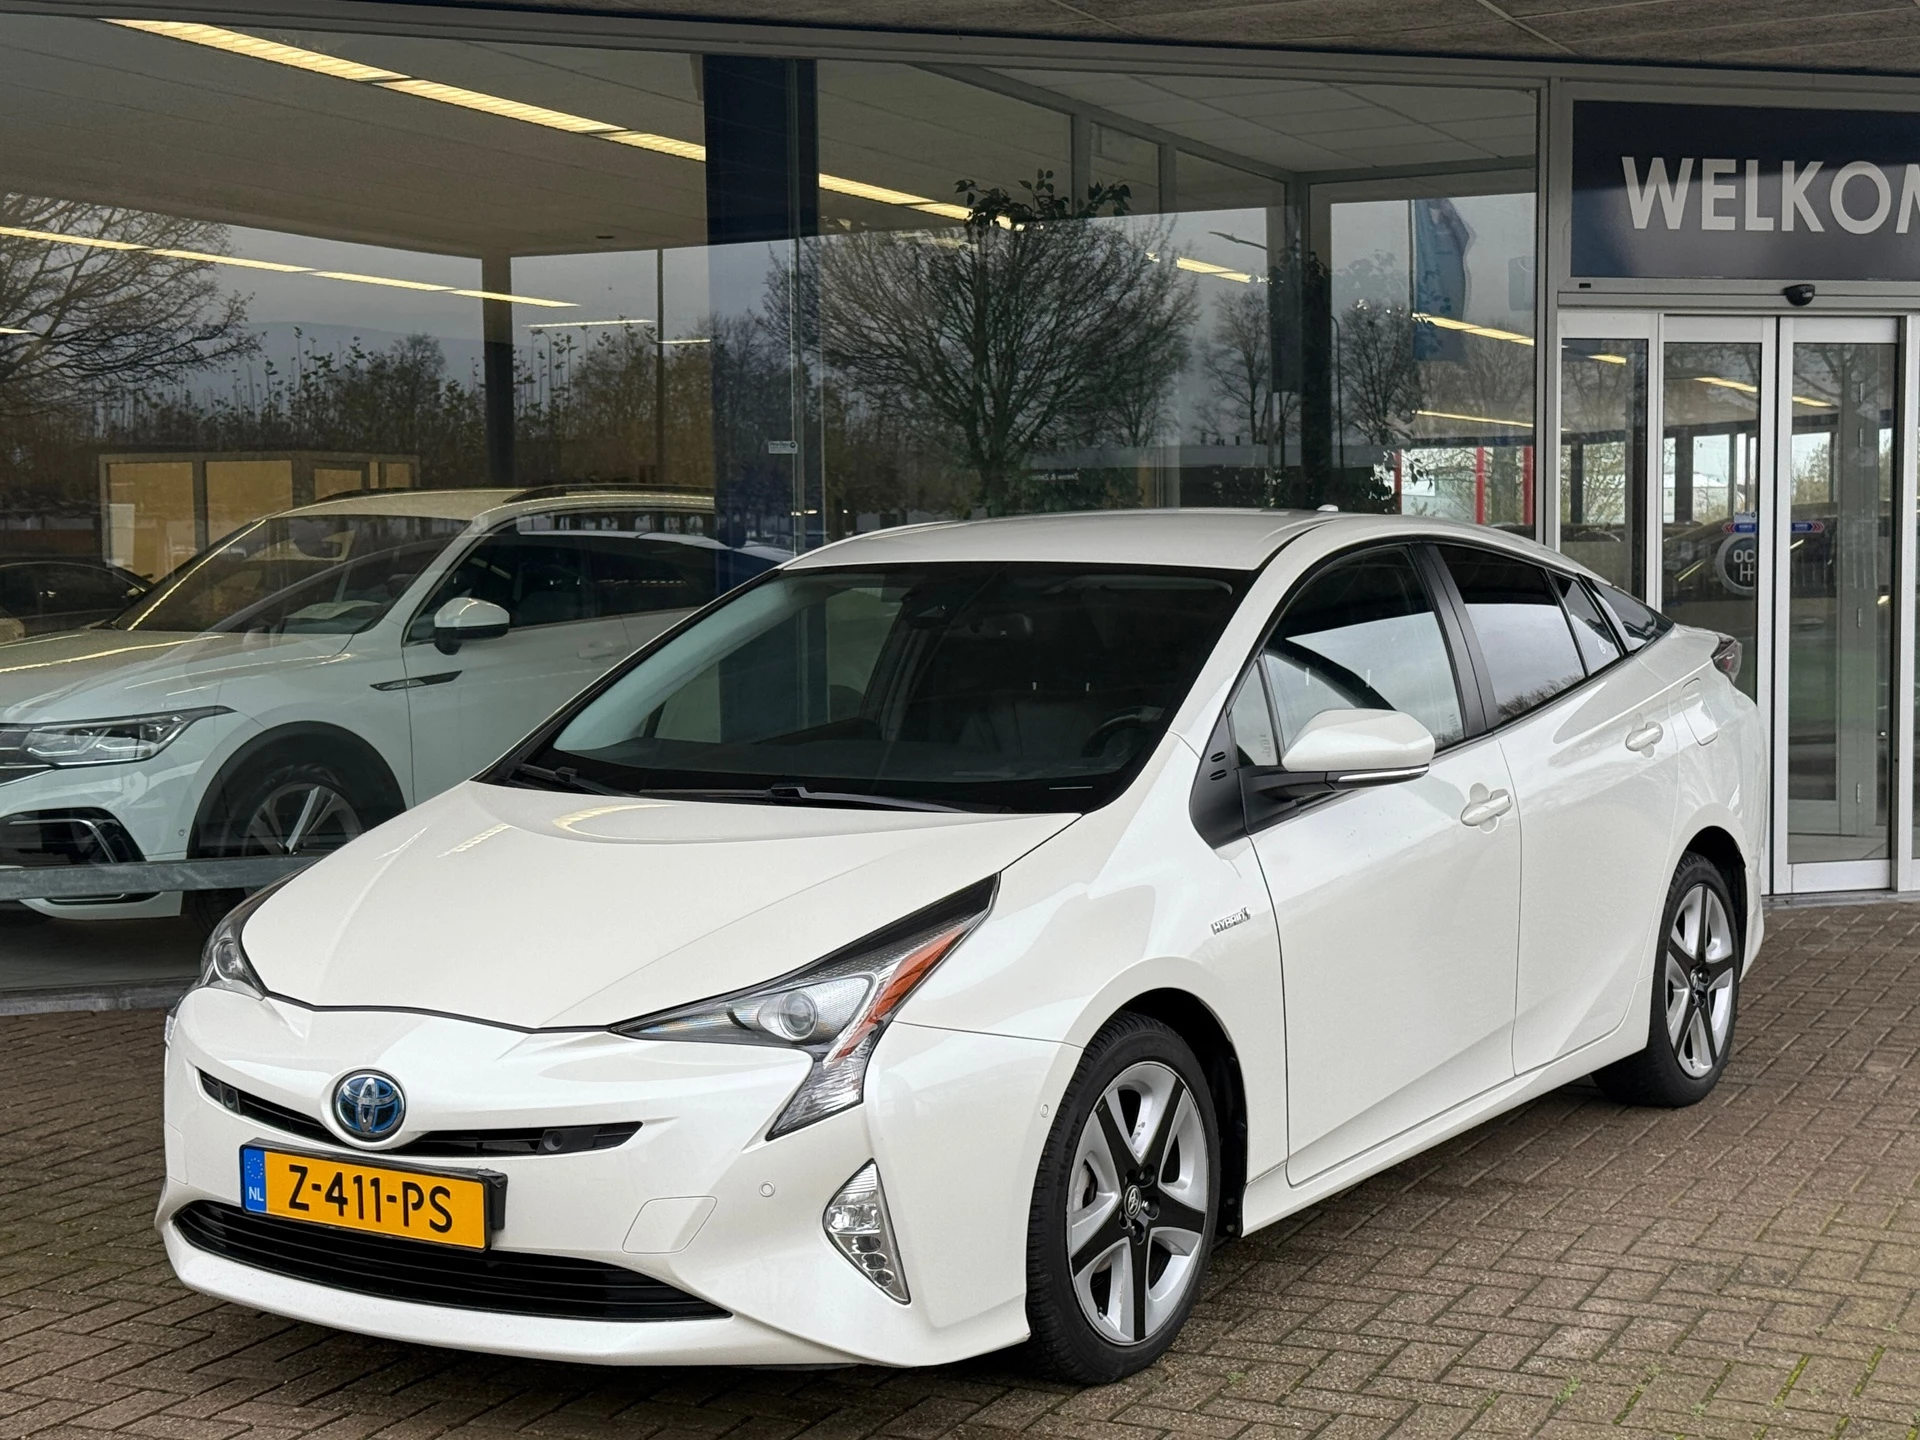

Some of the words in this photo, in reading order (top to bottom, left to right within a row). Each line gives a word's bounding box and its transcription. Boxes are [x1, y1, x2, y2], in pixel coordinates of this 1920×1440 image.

[1621, 155, 1920, 235] WELKO
[248, 1186, 265, 1202] NL
[288, 1164, 453, 1234] Z-411-PS
